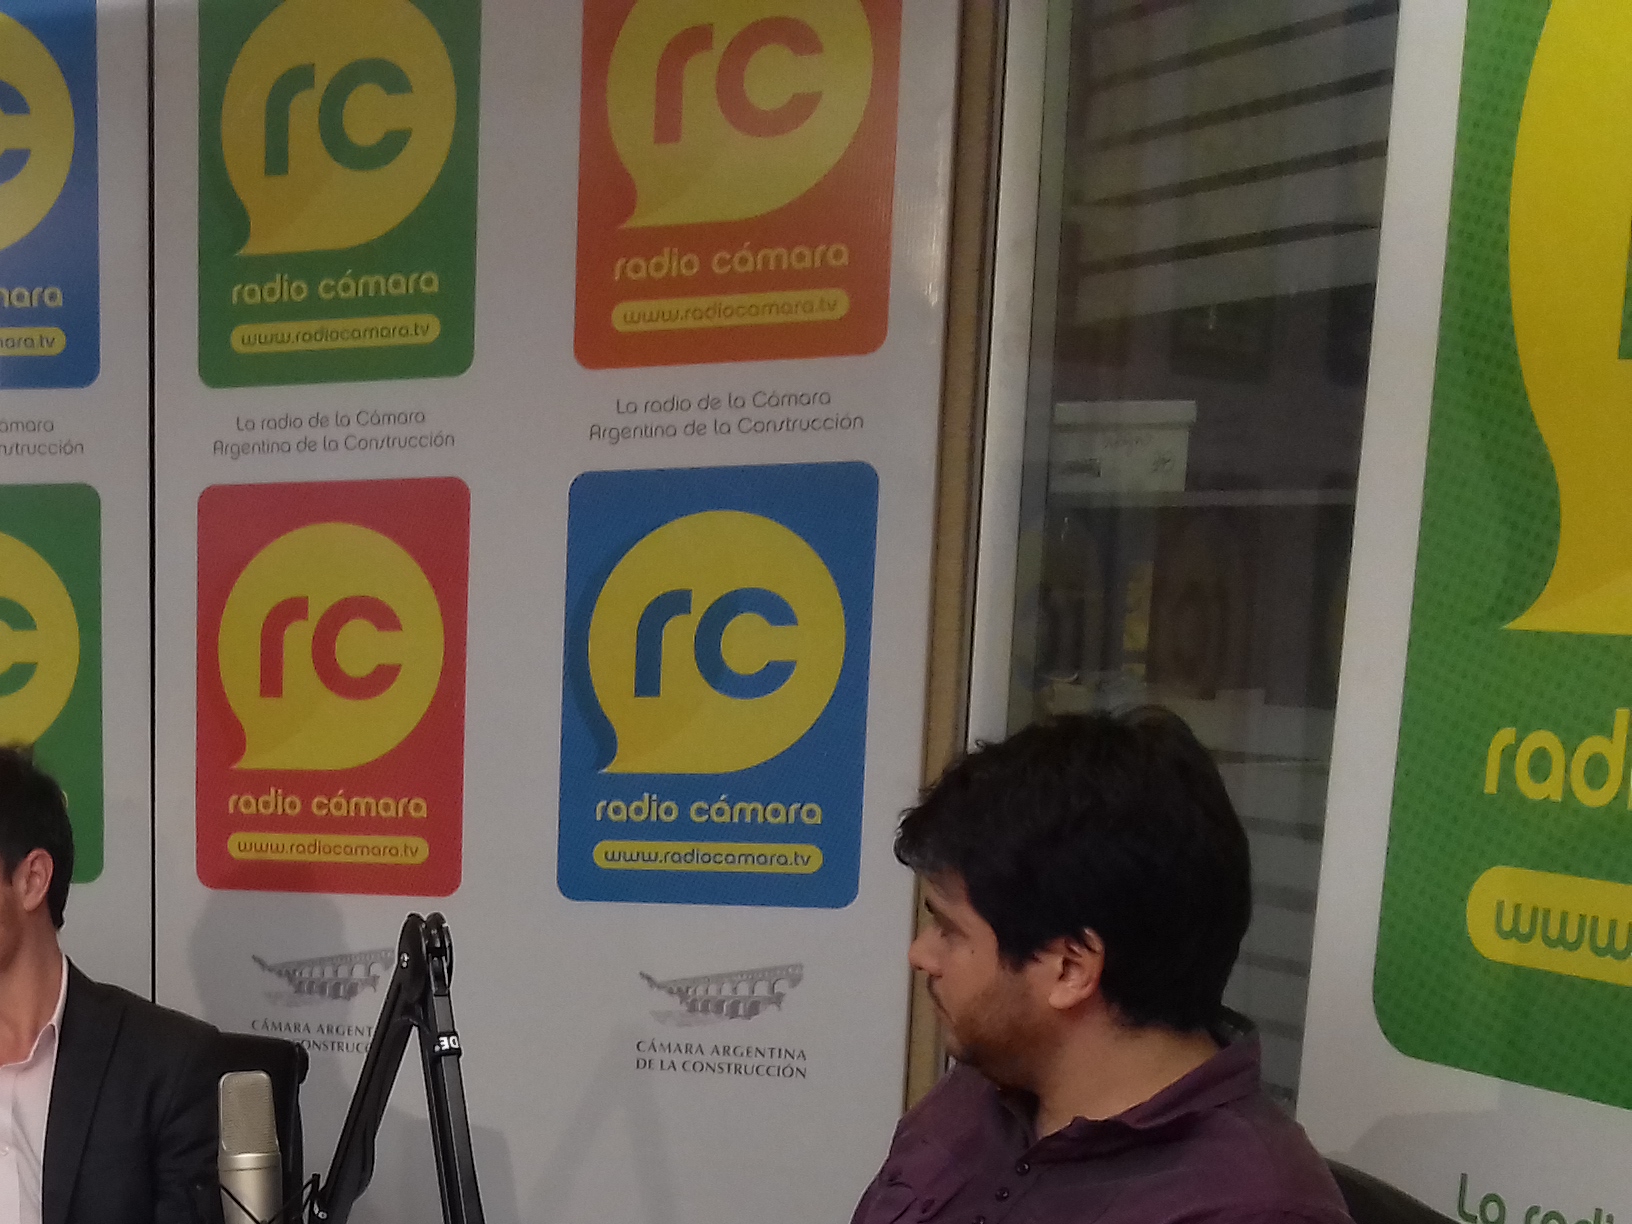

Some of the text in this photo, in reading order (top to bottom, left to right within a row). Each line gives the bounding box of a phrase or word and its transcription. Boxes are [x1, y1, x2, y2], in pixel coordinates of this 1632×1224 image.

[654, 15, 823, 145] rc
[265, 57, 413, 177] rc
[614, 241, 849, 281] radio cámara
[232, 269, 439, 305] radio cámara
[623, 296, 837, 325] www.radiocamara.tv
[242, 321, 429, 347] www.radiocamara.tv
[616, 390, 831, 415] La radio de la Cámara
[237, 409, 425, 432] La radio de la Cámara
[589, 414, 864, 445] Argentina de la Construcción
[214, 431, 455, 460] Argentina de la Construcción
[260, 595, 403, 700] rc
[634, 587, 798, 700] rc
[1484, 707, 1632, 809] rad
[229, 787, 427, 818] radio cámara
[595, 793, 822, 824] radio cámara
[238, 838, 419, 858] www.radiocamara.tv
[605, 847, 811, 868] www.radiocamara.tv
[316, 1023, 374, 1037] ARGENT
[636, 1037, 807, 1061] CÁMARA ARGENTINA
[636, 1057, 657, 1071] DE
[659, 1058, 678, 1072] LA
